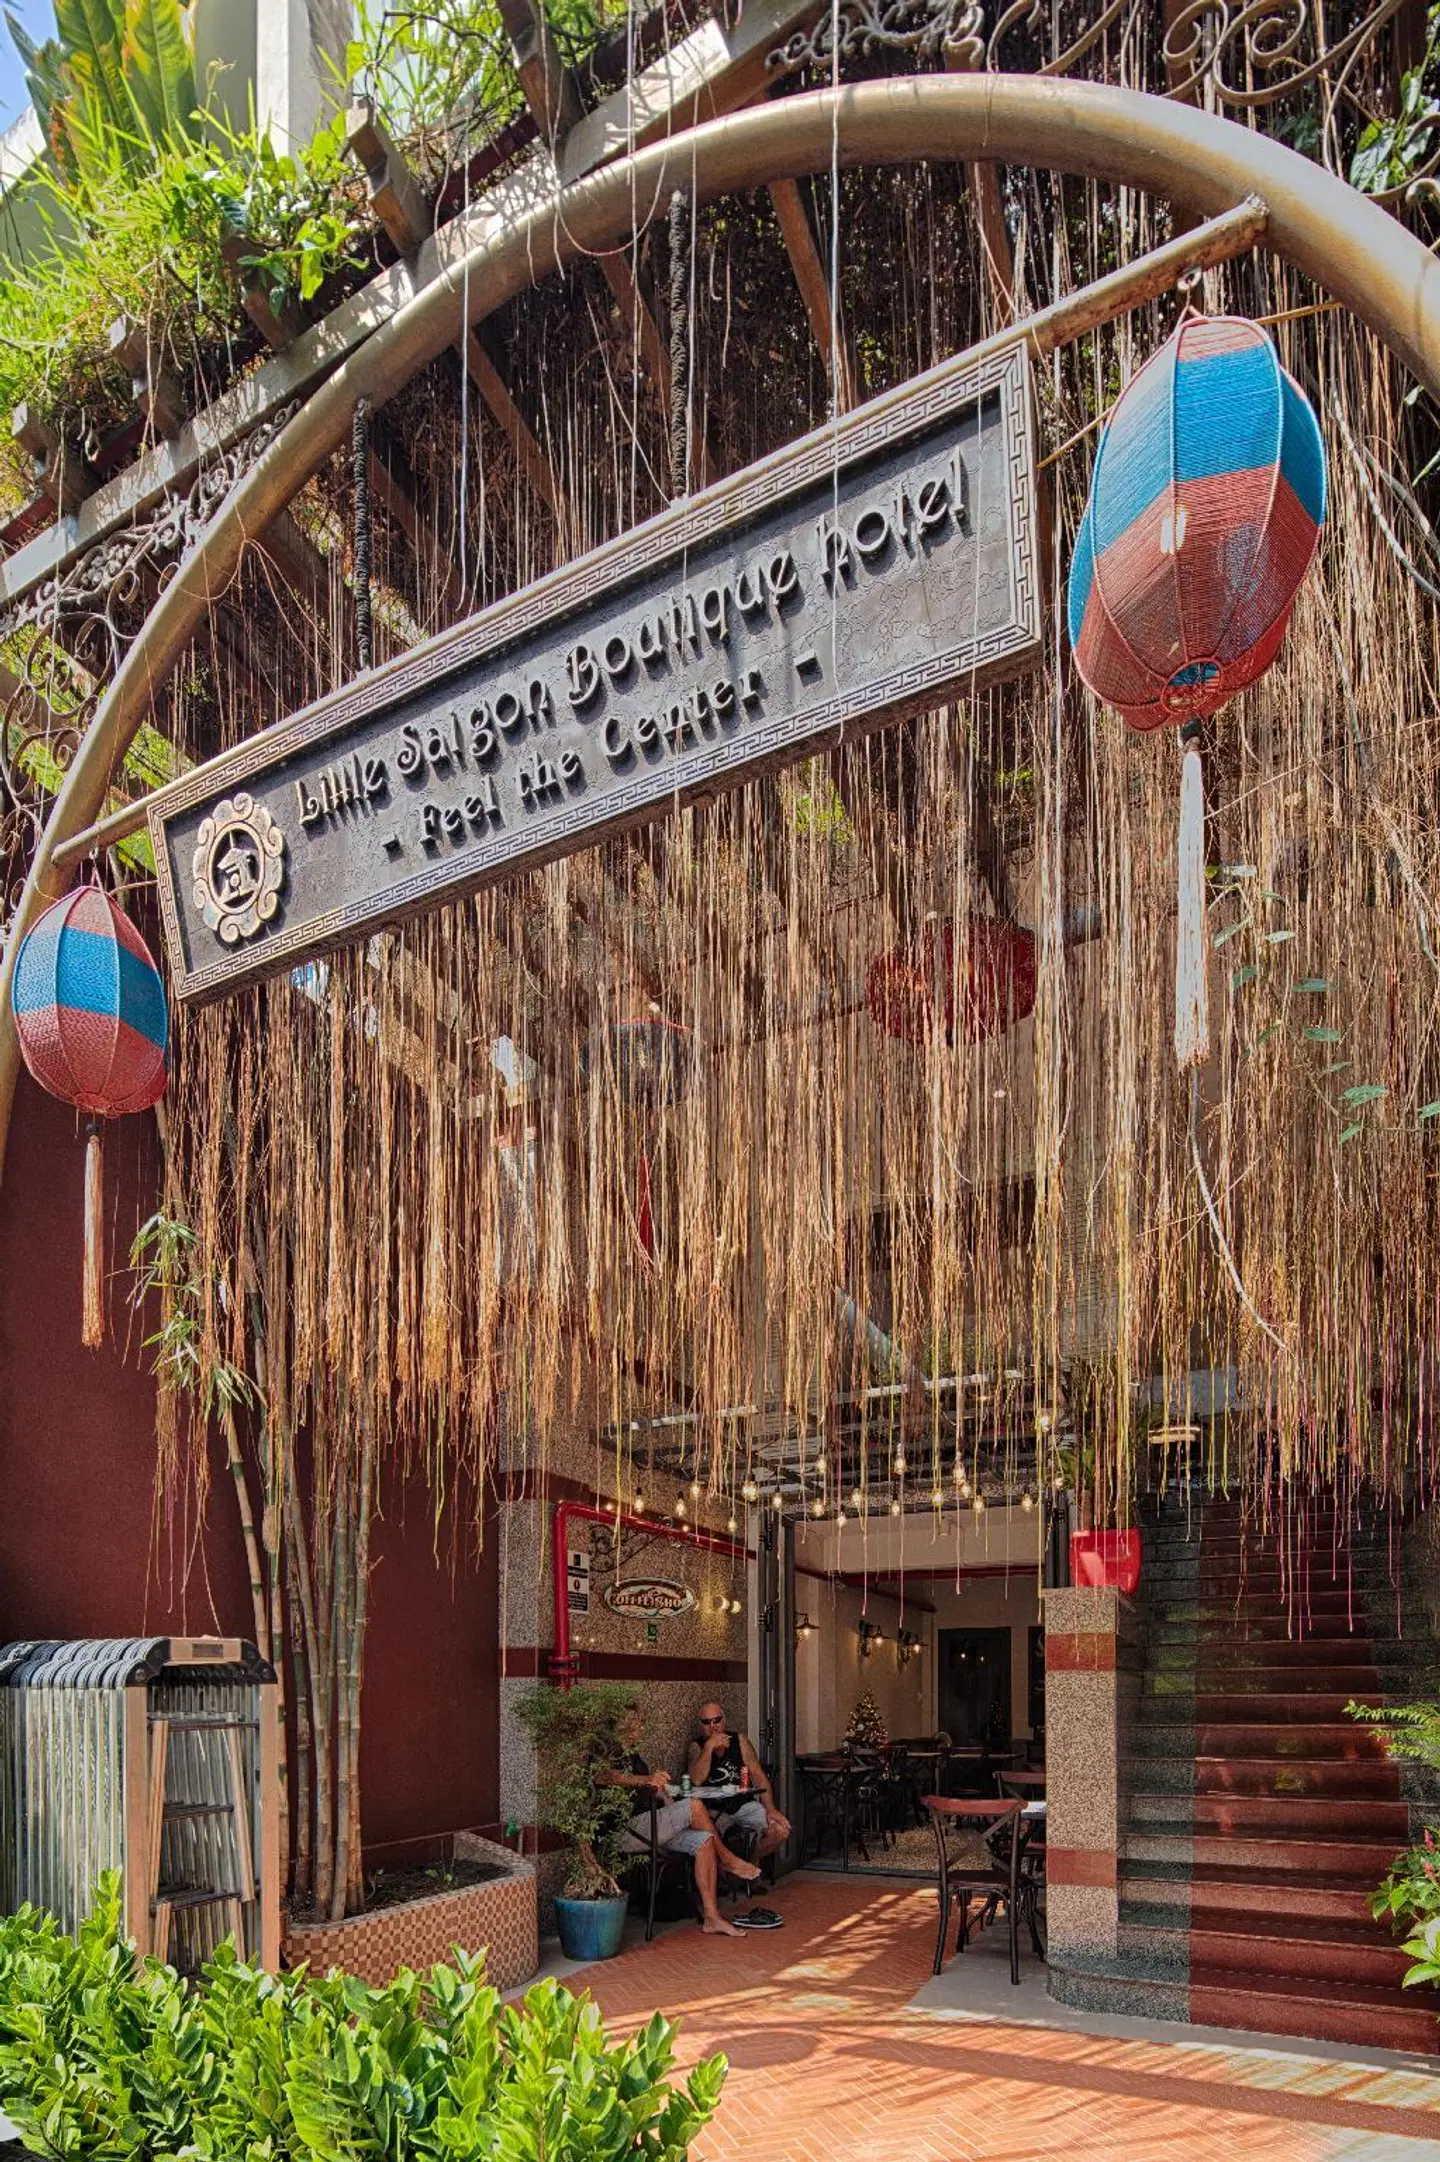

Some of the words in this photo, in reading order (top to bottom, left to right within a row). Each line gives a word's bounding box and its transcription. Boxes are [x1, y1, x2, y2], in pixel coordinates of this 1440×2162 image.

[295, 751, 387, 825] Little
[396, 678, 553, 776] Saigon
[566, 551, 798, 706] Boutique
[421, 776, 497, 844] Feel
[513, 747, 580, 799] the
[603, 667, 761, 757] Center
